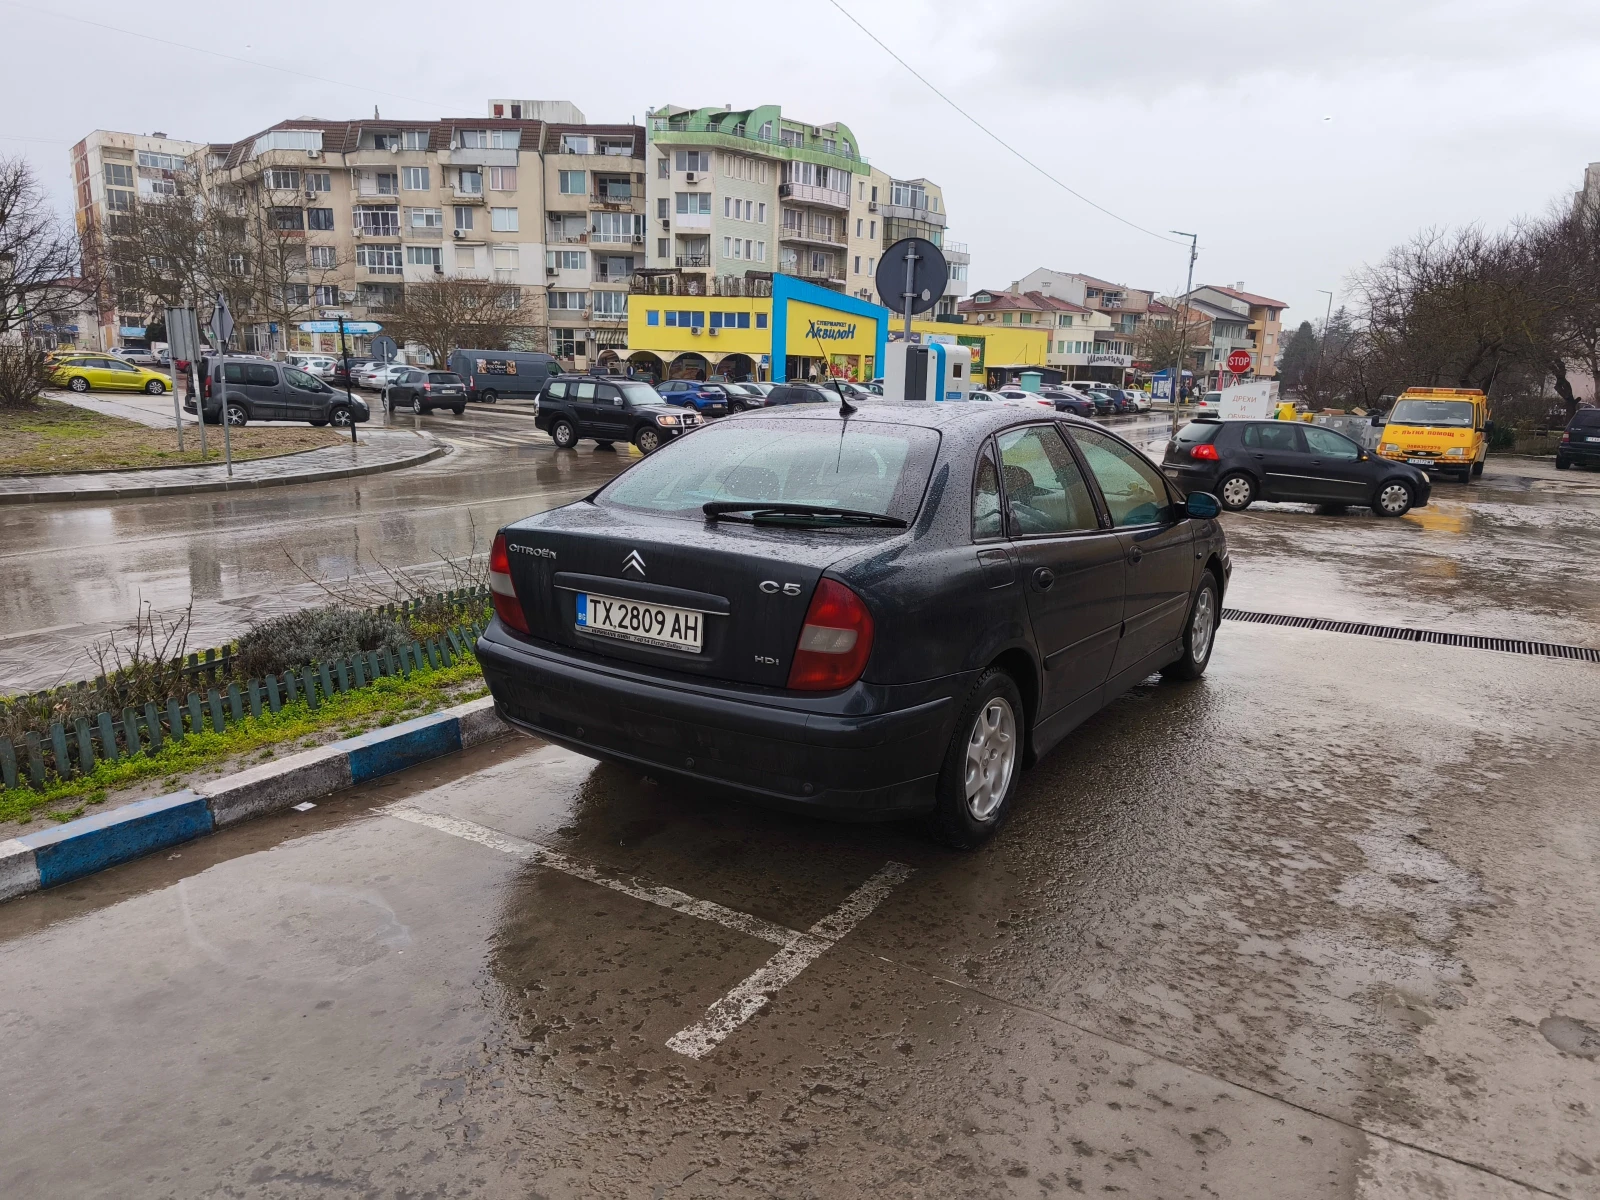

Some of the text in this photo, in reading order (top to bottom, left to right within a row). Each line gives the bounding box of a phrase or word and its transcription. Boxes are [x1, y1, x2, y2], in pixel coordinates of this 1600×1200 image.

[1229, 357, 1249, 366] STOP
[1232, 395, 1257, 403] ДРЕХИ
[508, 543, 557, 560] CITROËN
[758, 580, 803, 596] C5
[578, 612, 586, 621] BG
